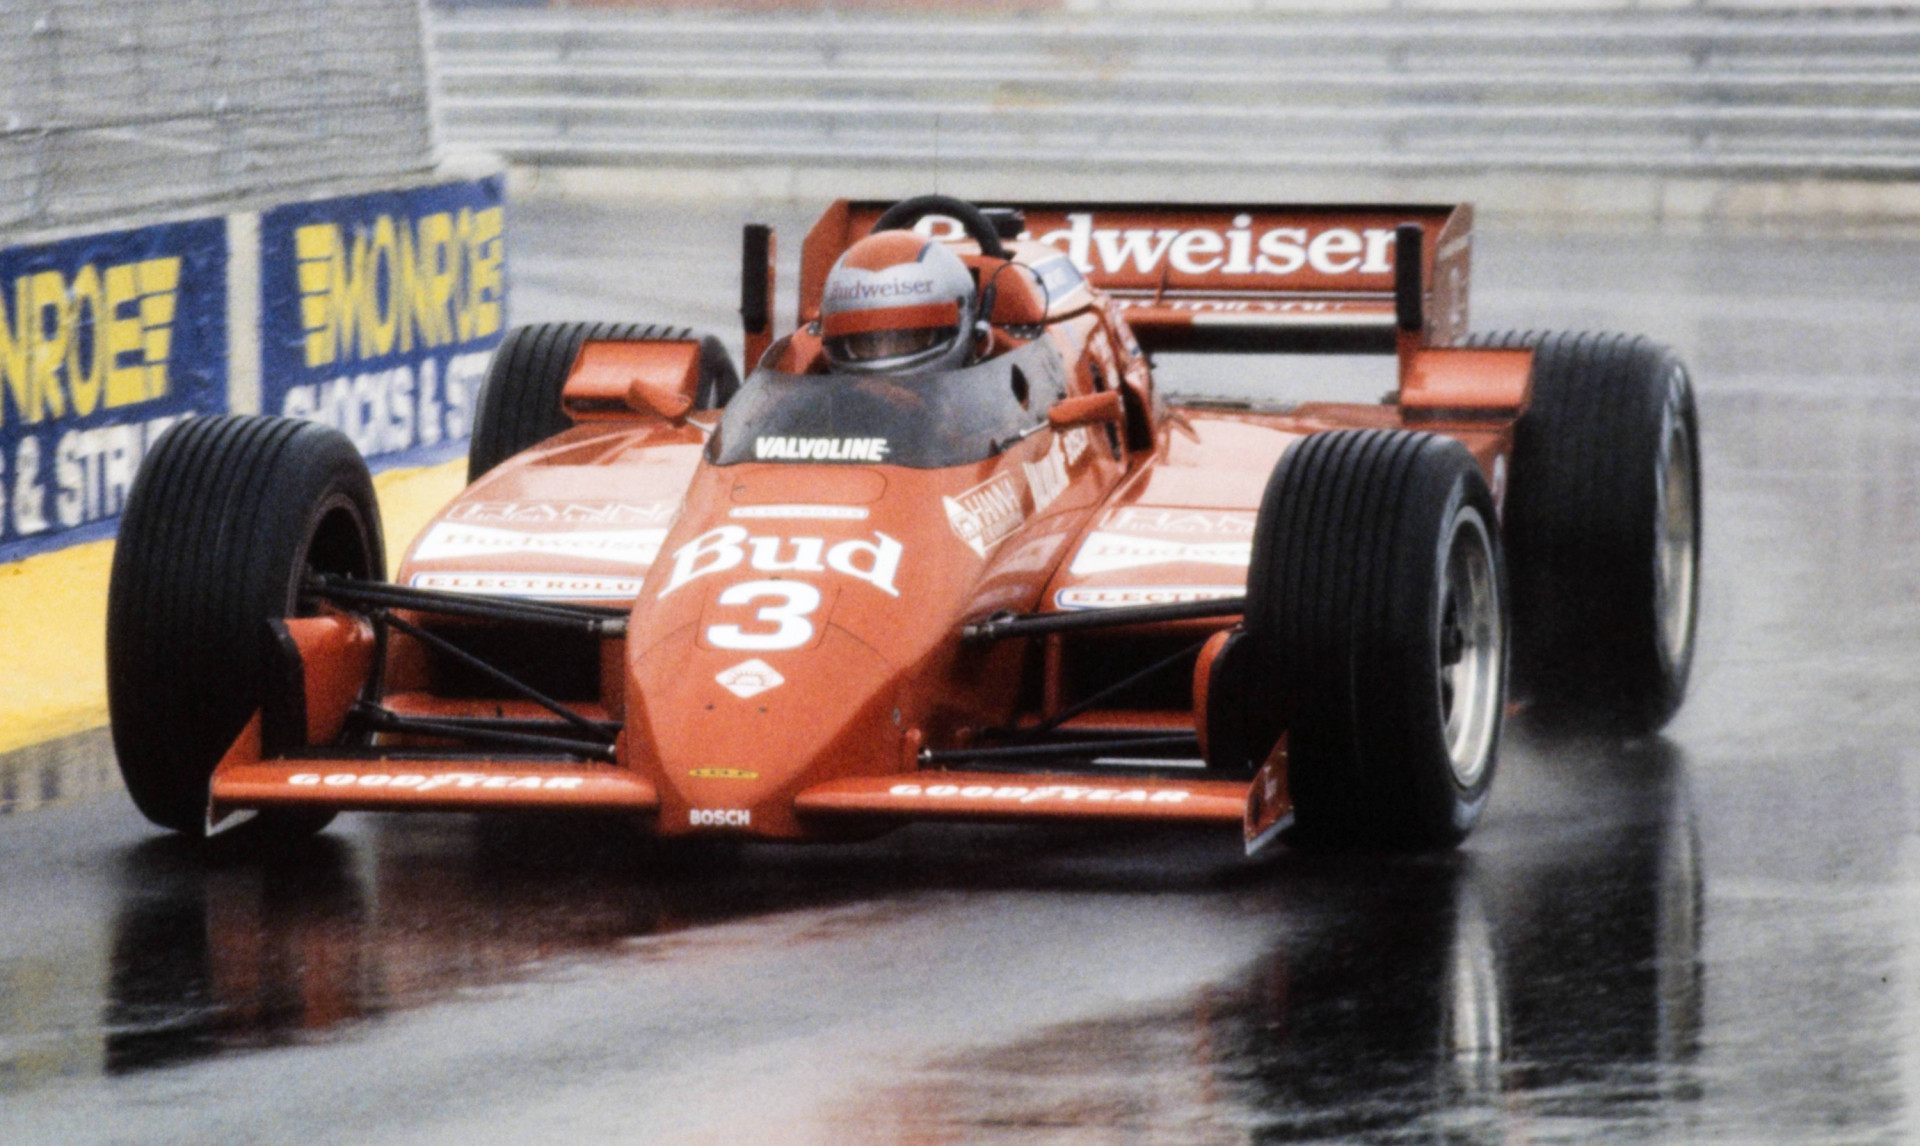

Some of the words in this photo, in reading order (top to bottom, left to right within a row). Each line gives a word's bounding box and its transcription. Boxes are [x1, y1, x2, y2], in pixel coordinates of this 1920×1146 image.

[912, 213, 1396, 274] Bdweiser
[294, 207, 505, 367] MONROE
[756, 437, 890, 461] VALVOLINE
[657, 525, 902, 600] Bud
[706, 579, 821, 650] 3
[288, 773, 583, 791] GOODYEAR
[889, 784, 1191, 804] GOODYEAR
[689, 808, 751, 826] BOSCH
